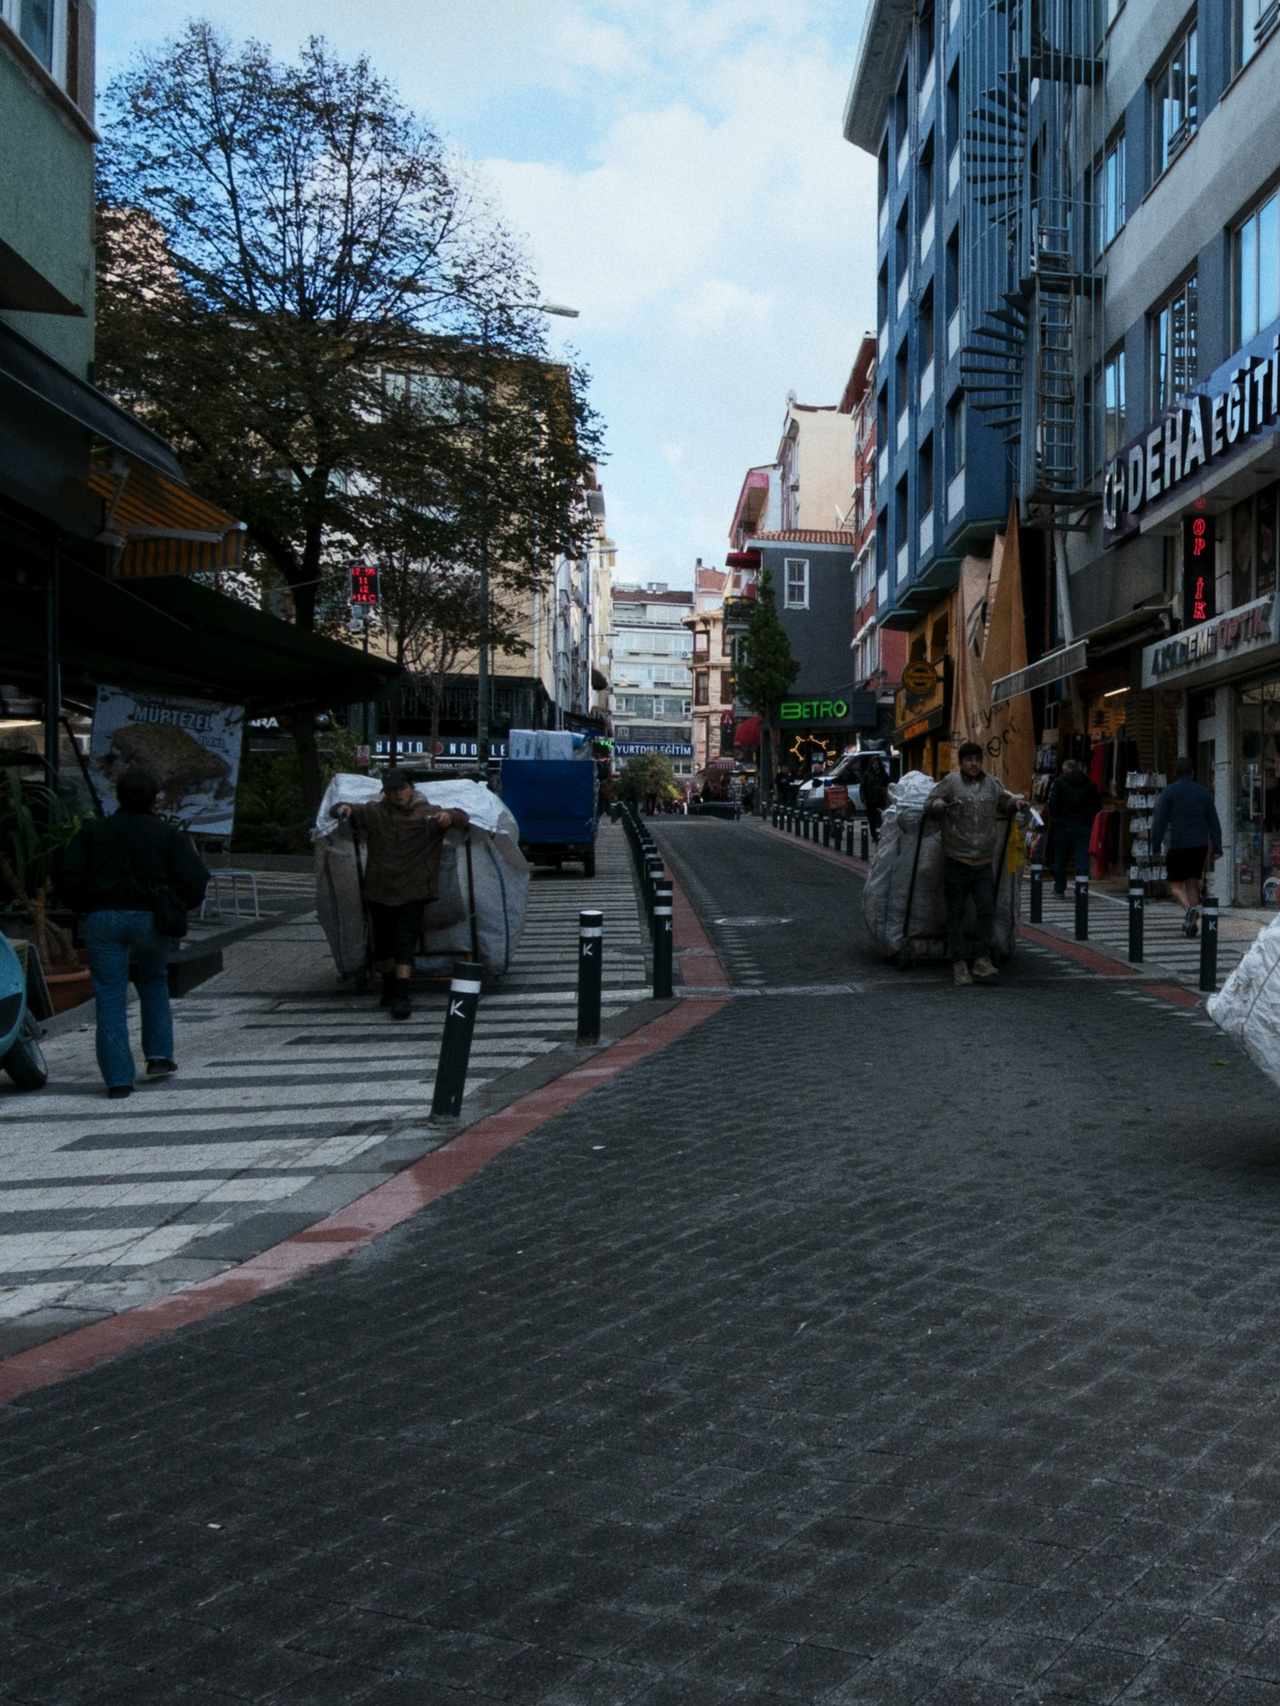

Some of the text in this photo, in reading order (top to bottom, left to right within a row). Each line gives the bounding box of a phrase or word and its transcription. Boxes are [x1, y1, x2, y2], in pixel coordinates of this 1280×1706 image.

[1128, 396, 1206, 514] DEHA
[133, 703, 213, 732] MÜPTEZEL
[780, 699, 848, 720] BETRO
[449, 742, 506, 756] NOOLE
